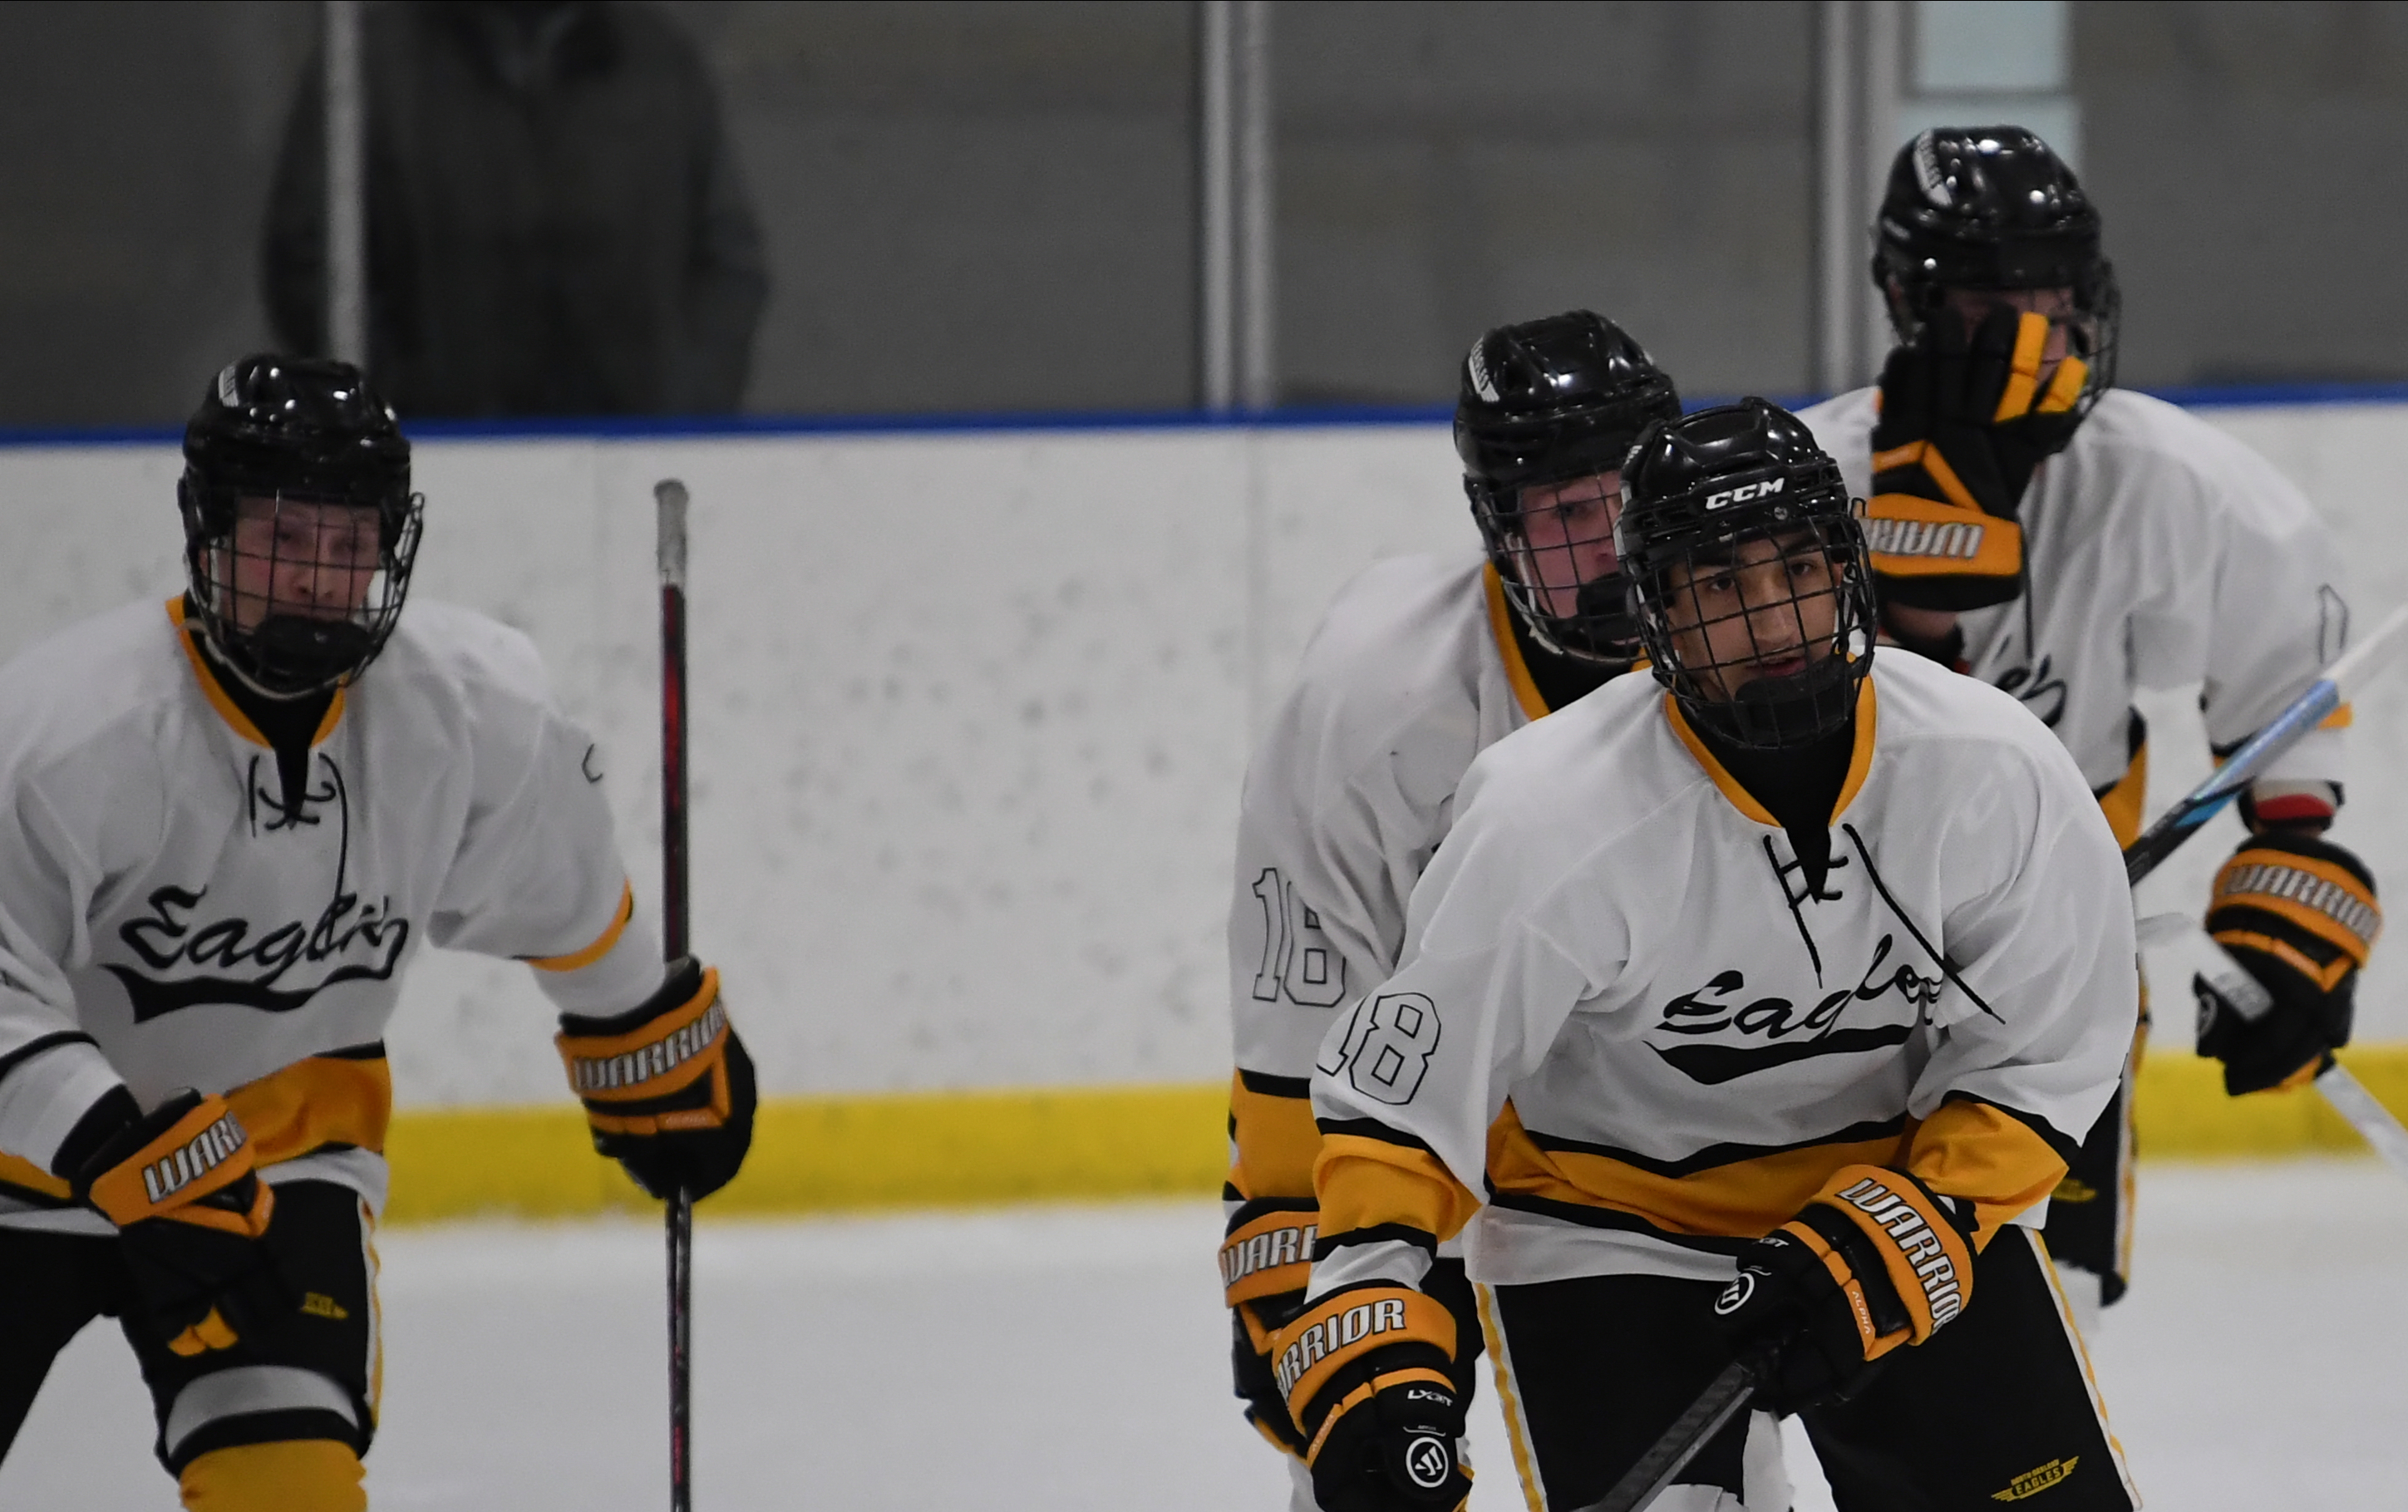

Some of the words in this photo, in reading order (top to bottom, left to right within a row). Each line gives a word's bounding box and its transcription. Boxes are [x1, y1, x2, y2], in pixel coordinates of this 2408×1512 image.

[1705, 477, 1785, 510] CCM
[1851, 1290, 1872, 1335] ALPHA
[2015, 1466, 2061, 1495] EAGLES
